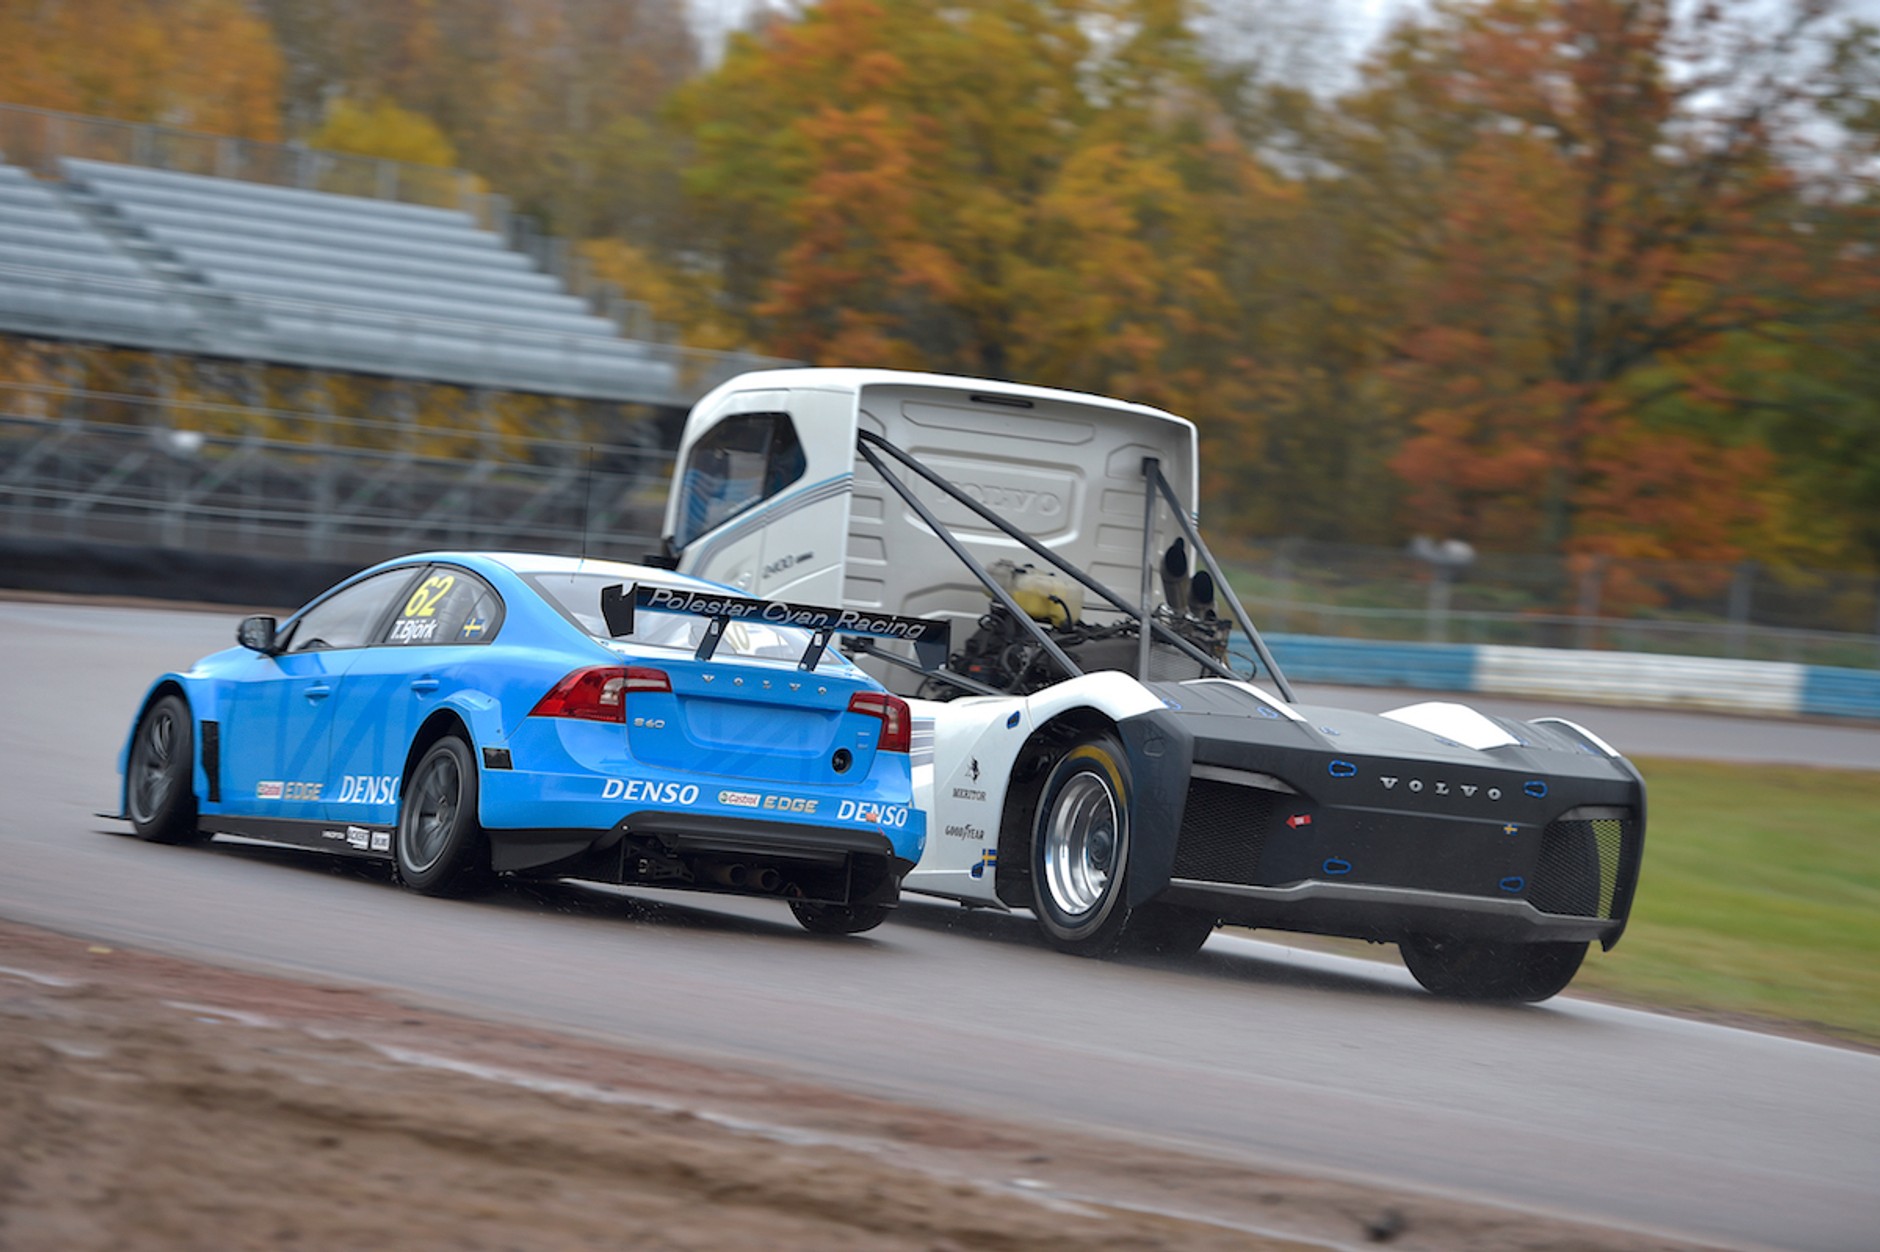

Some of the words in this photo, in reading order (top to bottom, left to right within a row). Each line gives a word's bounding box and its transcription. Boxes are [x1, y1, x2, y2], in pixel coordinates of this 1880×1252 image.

[404, 575, 455, 617] 62
[648, 589, 756, 618] Polestar
[762, 601, 827, 629] Cyan
[835, 610, 928, 640] Racing
[390, 619, 438, 644] T.Björk
[702, 673, 828, 695] VOLVO
[633, 717, 666, 729] S60
[284, 781, 324, 801] EDGE
[601, 778, 700, 805] DENSO
[952, 787, 987, 802] MERITOR
[1379, 776, 1502, 800] VOLVO
[728, 793, 758, 806] Castrol
[762, 795, 819, 814] EDGE
[836, 800, 909, 828] DENSO
[944, 824, 985, 841] GOODYEAR
